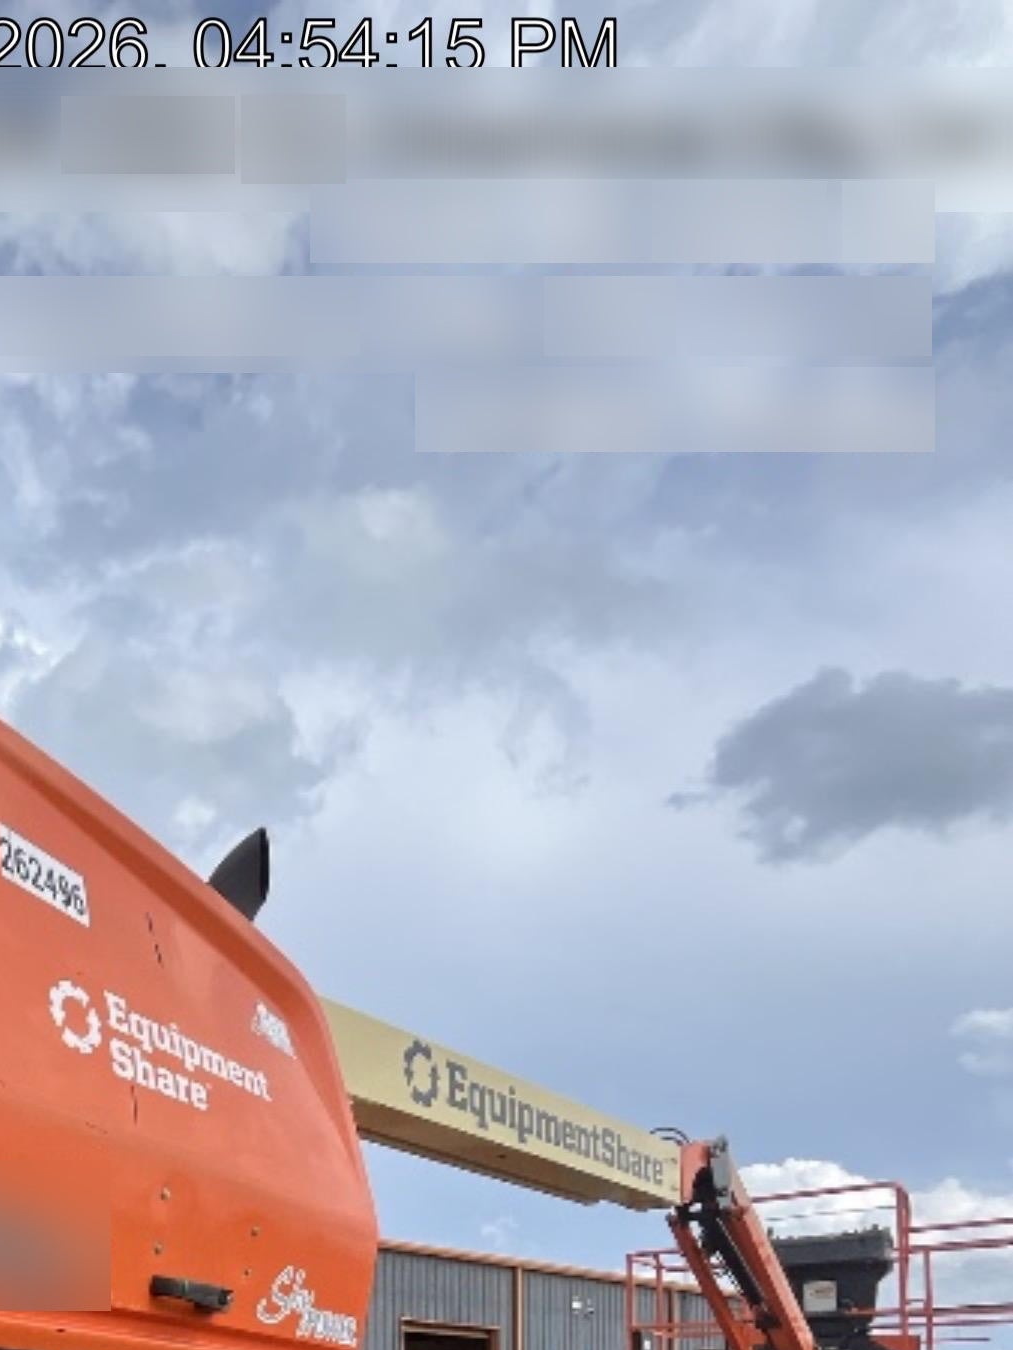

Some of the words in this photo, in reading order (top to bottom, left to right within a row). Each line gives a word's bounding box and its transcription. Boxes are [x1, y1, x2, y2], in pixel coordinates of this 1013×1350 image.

[0, 837, 85, 916] 262496
[103, 989, 273, 1101] Equipment
[109, 1037, 208, 1110] Share
[445, 1058, 665, 1185] EquipmentShare
